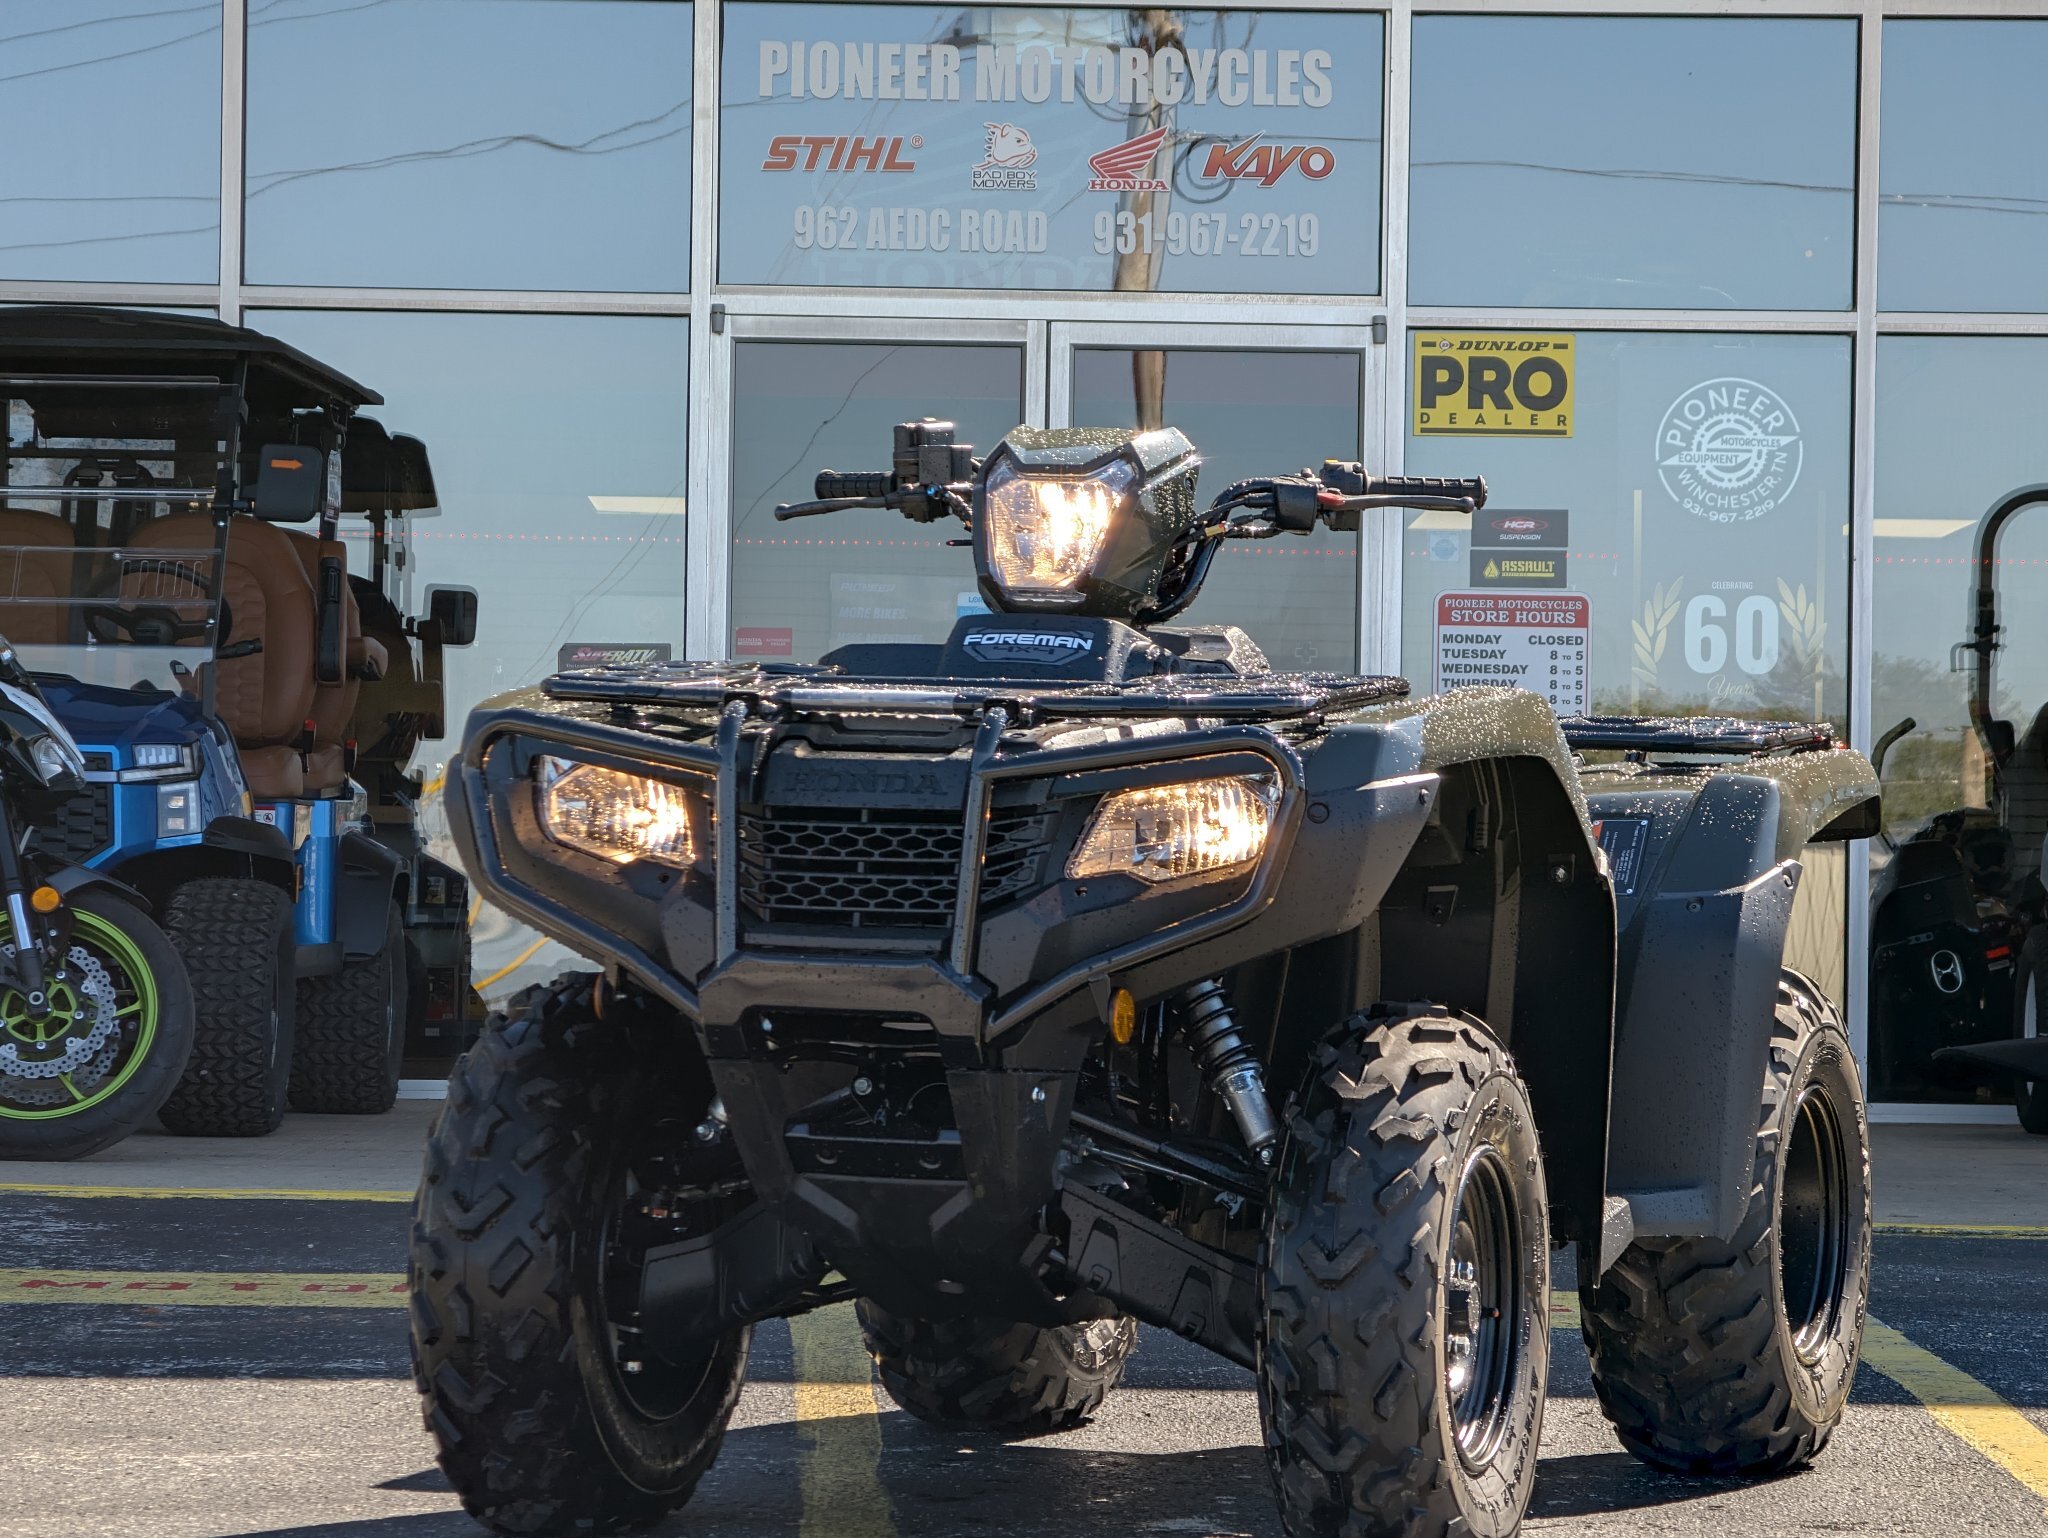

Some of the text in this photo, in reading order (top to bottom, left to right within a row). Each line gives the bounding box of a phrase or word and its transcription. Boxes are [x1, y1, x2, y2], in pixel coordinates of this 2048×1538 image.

[759, 40, 1333, 108] PIONEER MOTORCYCLES
[761, 135, 916, 172] STIHL
[1200, 130, 1337, 189] KAYO
[972, 170, 1038, 180] BAD BOY
[972, 179, 1037, 190] MOWERS
[1088, 178, 1171, 191] HONDA
[794, 205, 1048, 254] 962 AEDC ROAD
[1093, 210, 1320, 258] 931-967-2219
[1456, 340, 1550, 352] DUNLOP
[1420, 355, 1568, 412] PRO
[1420, 412, 1567, 427] DEALER
[1665, 386, 1785, 447] PIONEER
[1720, 436, 1782, 448] MOTORCYCLES
[1678, 452, 1740, 465] EQUIPMENT
[1682, 497, 1775, 523] 931-967-2219
[1503, 520, 1536, 529] HCR
[1501, 560, 1555, 573] ASSAULT
[1711, 581, 1753, 590] CELEBRATING
[1444, 598, 1582, 610] PIONEER MOTORCYCLES
[1451, 610, 1576, 624] STORE HOURS
[1442, 633, 1584, 646] MONDAY CLOSED
[1684, 594, 1779, 675] 60
[963, 633, 1093, 651] FOREMAN
[1442, 648, 1507, 660] TUESDAY
[1549, 650, 1558, 661] 8
[1575, 650, 1584, 661] 5
[1442, 663, 1529, 674] WEDNESDAY
[1549, 665, 1558, 675] 8
[1575, 665, 1584, 676] 5
[1442, 678, 1518, 689] THURSDAY
[1549, 679, 1558, 690] 8
[1575, 680, 1583, 691] 5
[1706, 673, 1755, 704] Years
[1549, 694, 1558, 705] 8
[1575, 695, 1583, 705] 5
[783, 770, 949, 795] HONDA
[17, 1278, 410, 1293] MOTO
